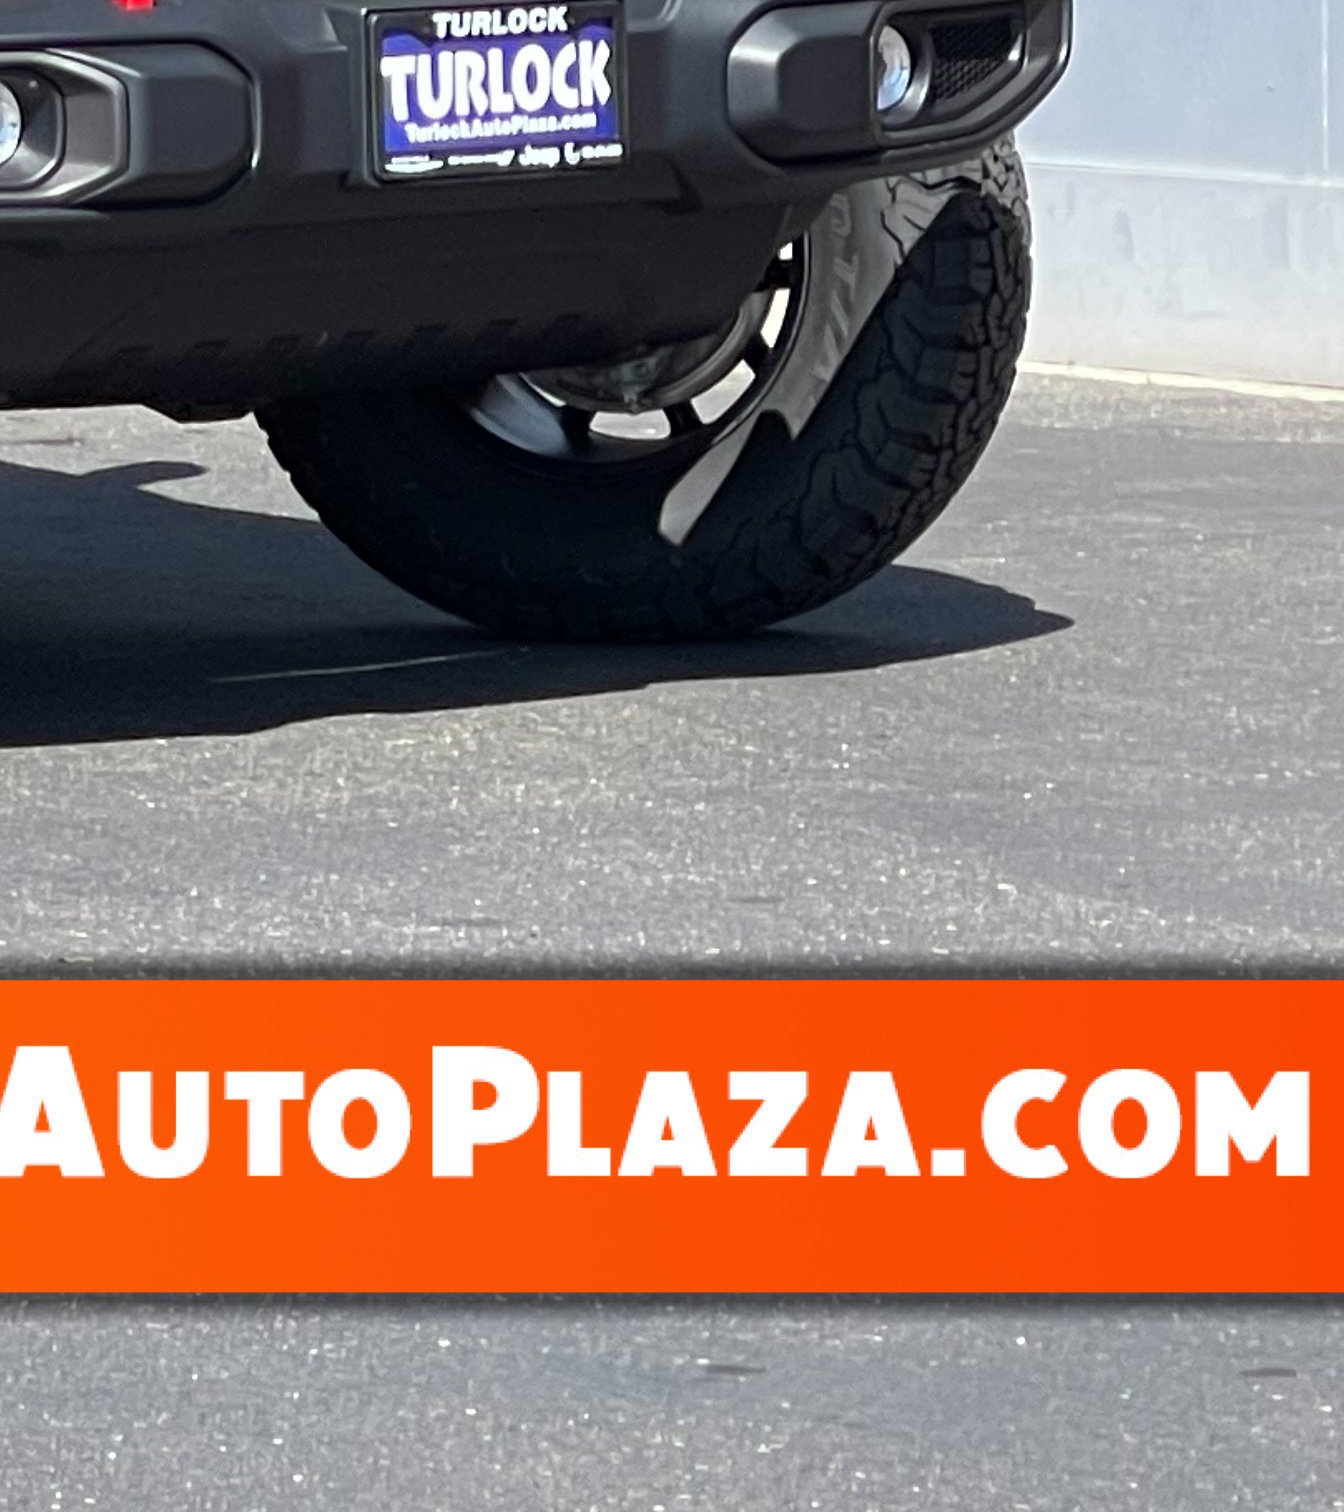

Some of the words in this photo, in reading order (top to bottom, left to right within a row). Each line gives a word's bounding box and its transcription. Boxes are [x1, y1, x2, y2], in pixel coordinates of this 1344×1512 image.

[431, 5, 568, 39] TURLOCK
[380, 39, 612, 123] TURLOCK
[404, 112, 598, 144] TurlockAutoPlaza.com
